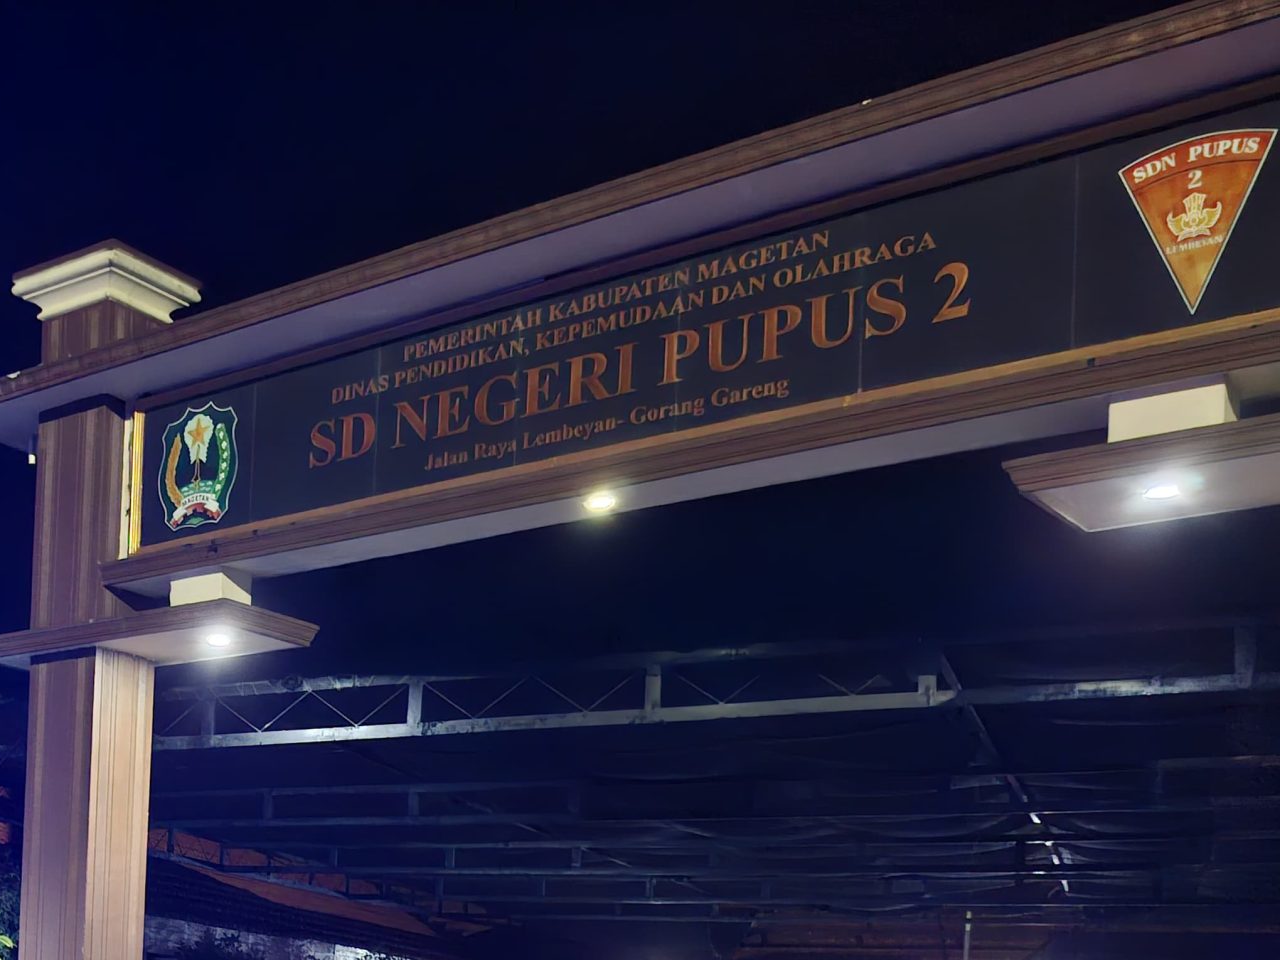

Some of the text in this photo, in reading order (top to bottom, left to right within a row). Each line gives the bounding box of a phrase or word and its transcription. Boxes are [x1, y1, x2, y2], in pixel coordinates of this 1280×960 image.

[1132, 137, 1261, 183] SDN PUPUS
[1187, 169, 1203, 189] 2
[331, 232, 937, 405] DINAS PENDIDIKAN, KEPEMUDAAN DAN OLAHRAGA
[403, 230, 830, 363] PEMERINTAH KABUPATEN MAGETAN
[309, 262, 971, 469] SD NEGERI PUPUS 2
[424, 379, 791, 472] Jalan Raya Lembeyan- Gorang Gareng
